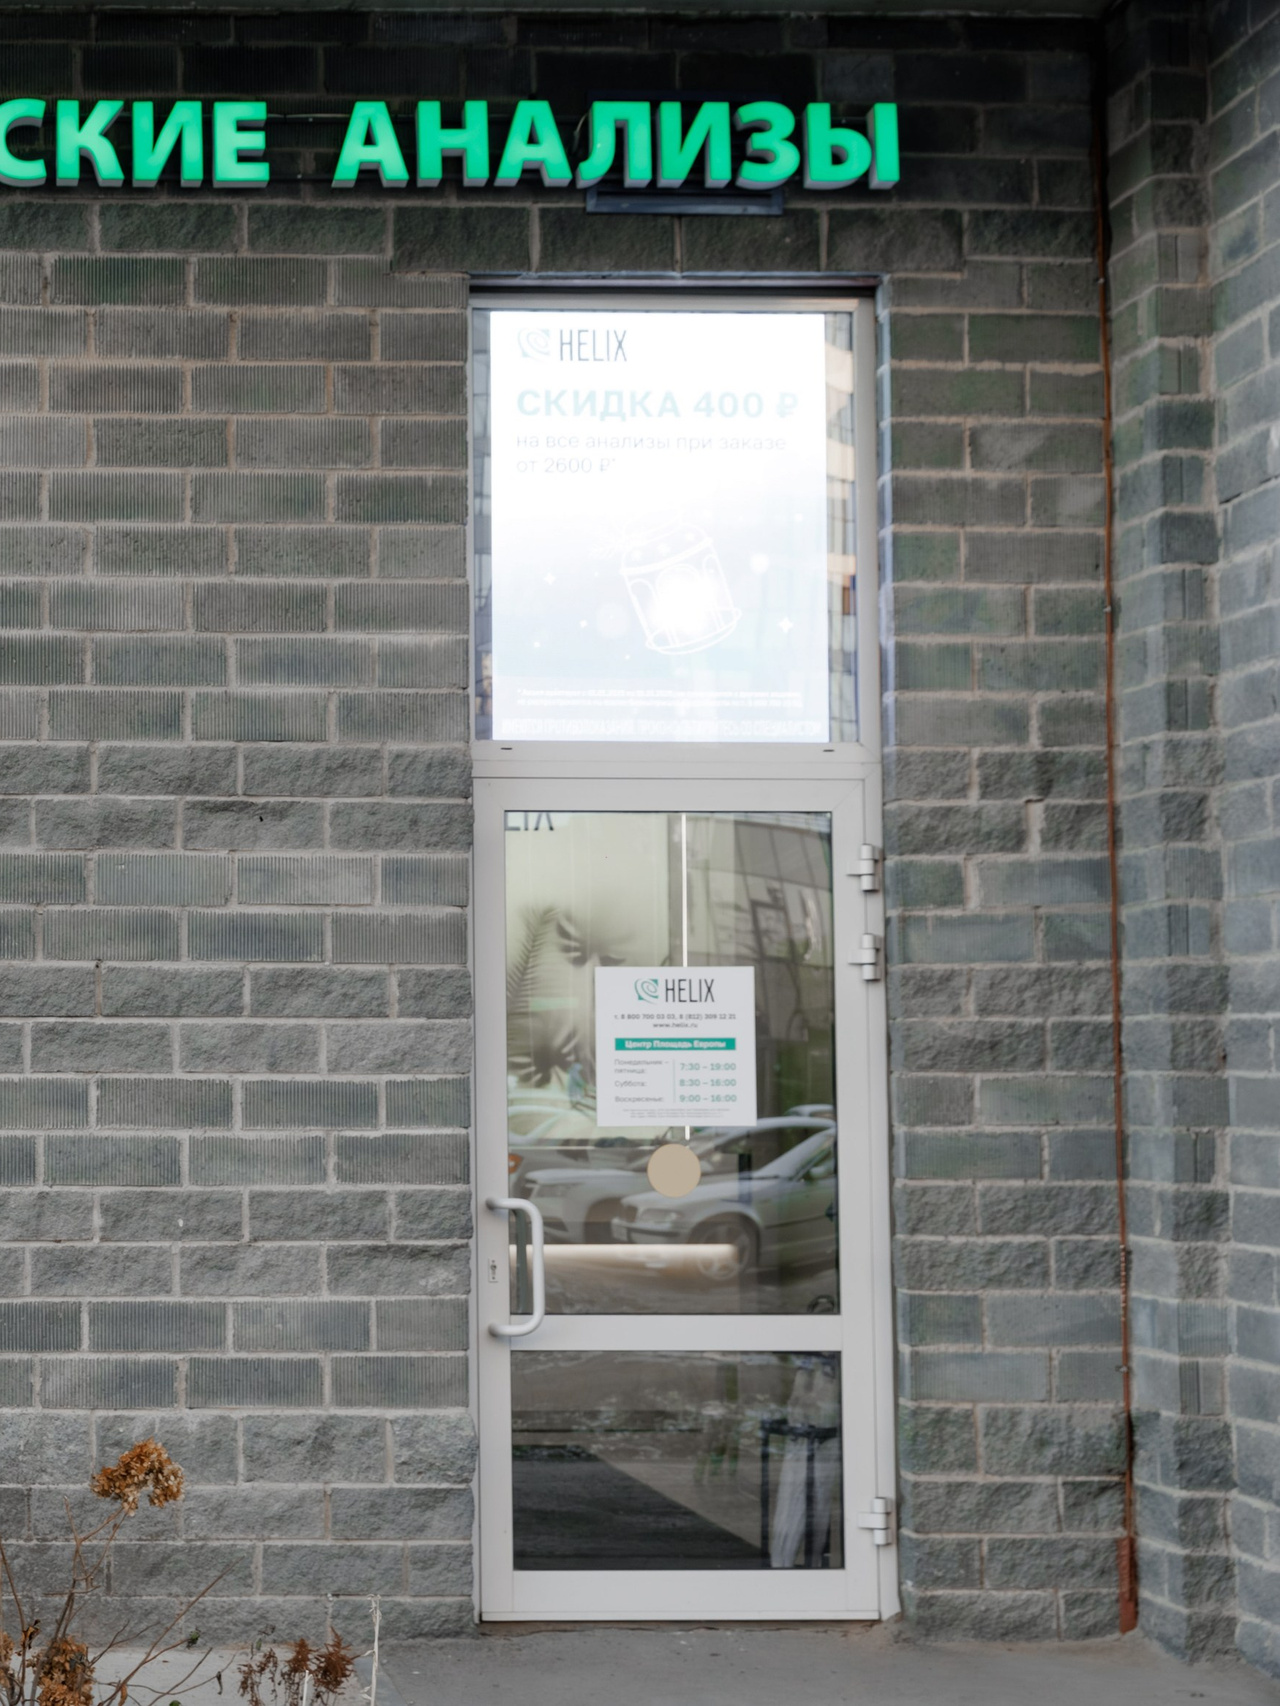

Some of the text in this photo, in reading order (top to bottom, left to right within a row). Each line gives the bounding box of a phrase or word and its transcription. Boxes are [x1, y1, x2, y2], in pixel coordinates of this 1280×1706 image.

[331, 99, 900, 189] АНАЛИЗЫ
[559, 328, 628, 362] HELIX
[516, 388, 681, 423] СКИДКА
[692, 391, 764, 419] 400
[516, 435, 787, 454] на все анализы при заказе
[516, 459, 539, 474] от
[544, 457, 593, 474] 2600
[664, 978, 715, 1003] HELIX
[679, 1062, 701, 1072] 7:30
[679, 1078, 701, 1088] 8:30
